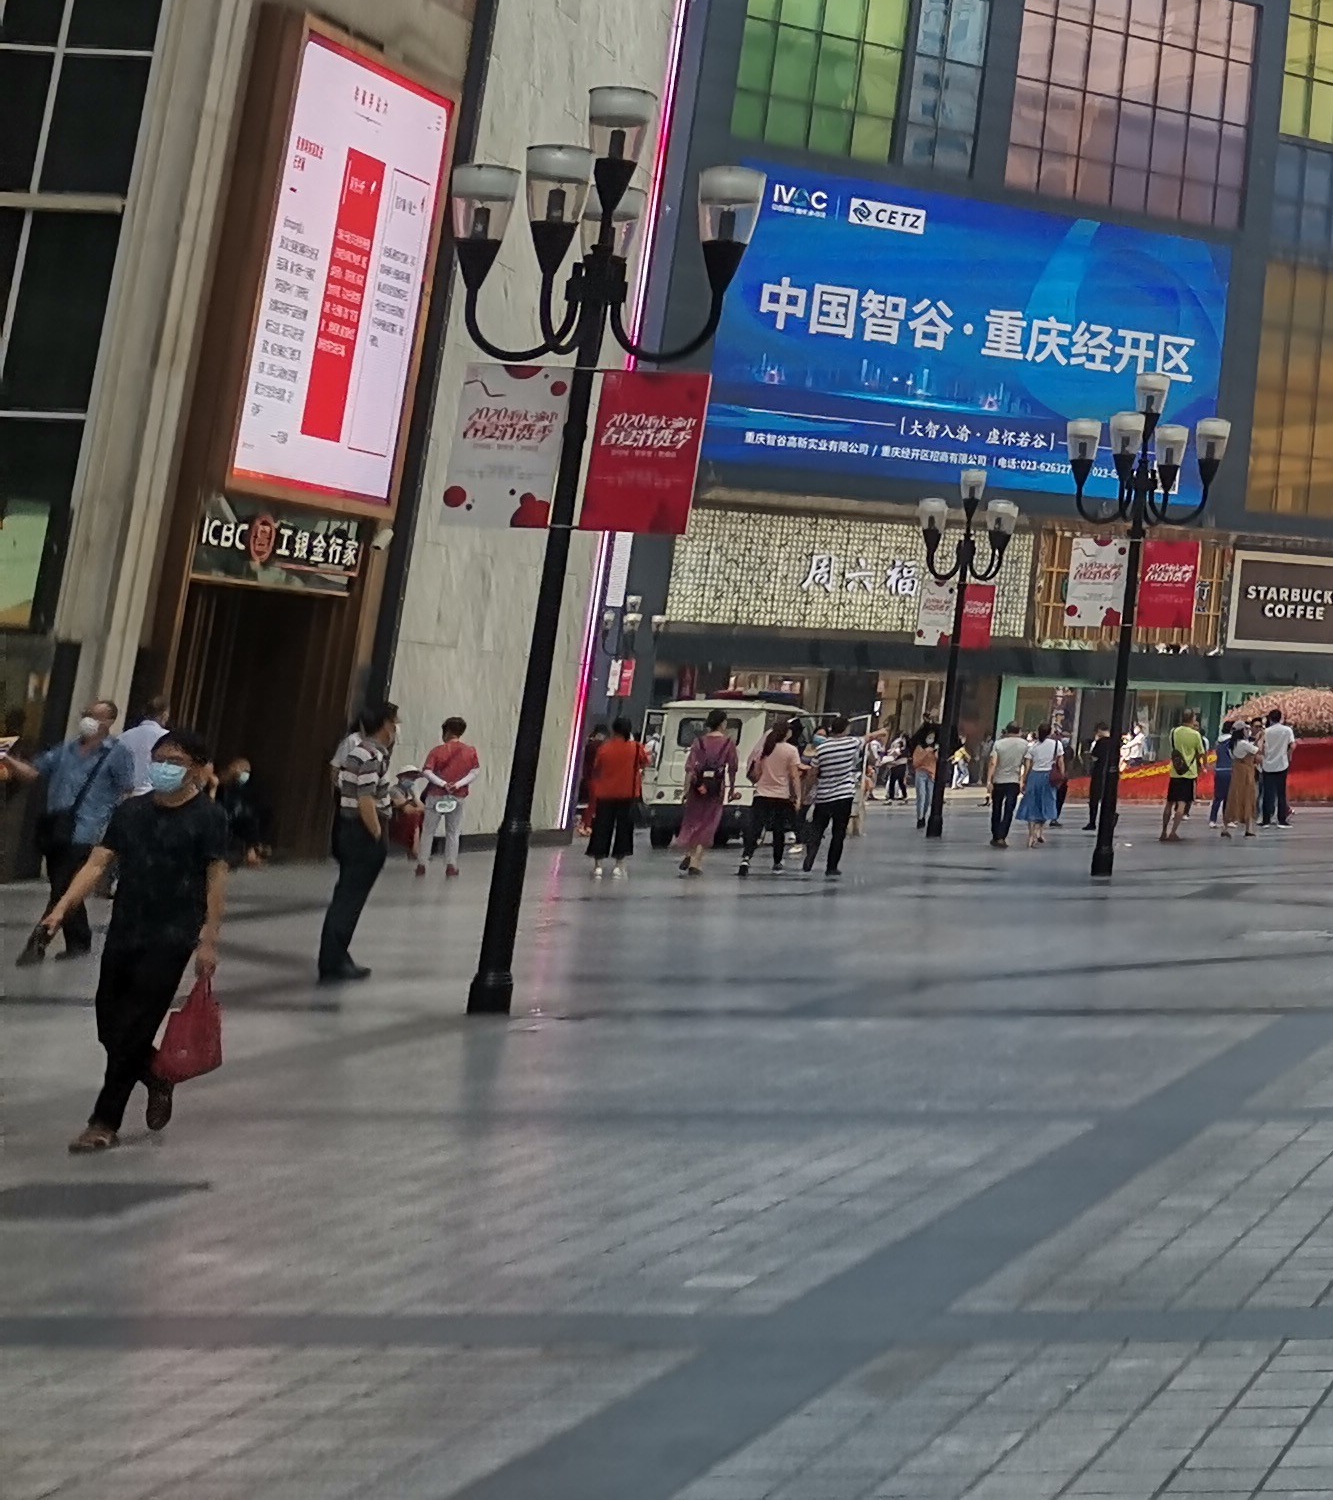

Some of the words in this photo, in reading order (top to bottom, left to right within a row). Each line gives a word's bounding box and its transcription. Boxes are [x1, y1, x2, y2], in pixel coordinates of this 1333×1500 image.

[875, 209, 922, 229] CETZ
[759, 277, 1197, 383] 中国智谷·重庆经开区
[909, 420, 1047, 448] 大智入渝·虚怀若谷
[202, 516, 249, 550] ICBC
[276, 528, 359, 566] 工银金行家
[801, 555, 919, 597] 周六福
[1264, 603, 1325, 620] COFFEE
